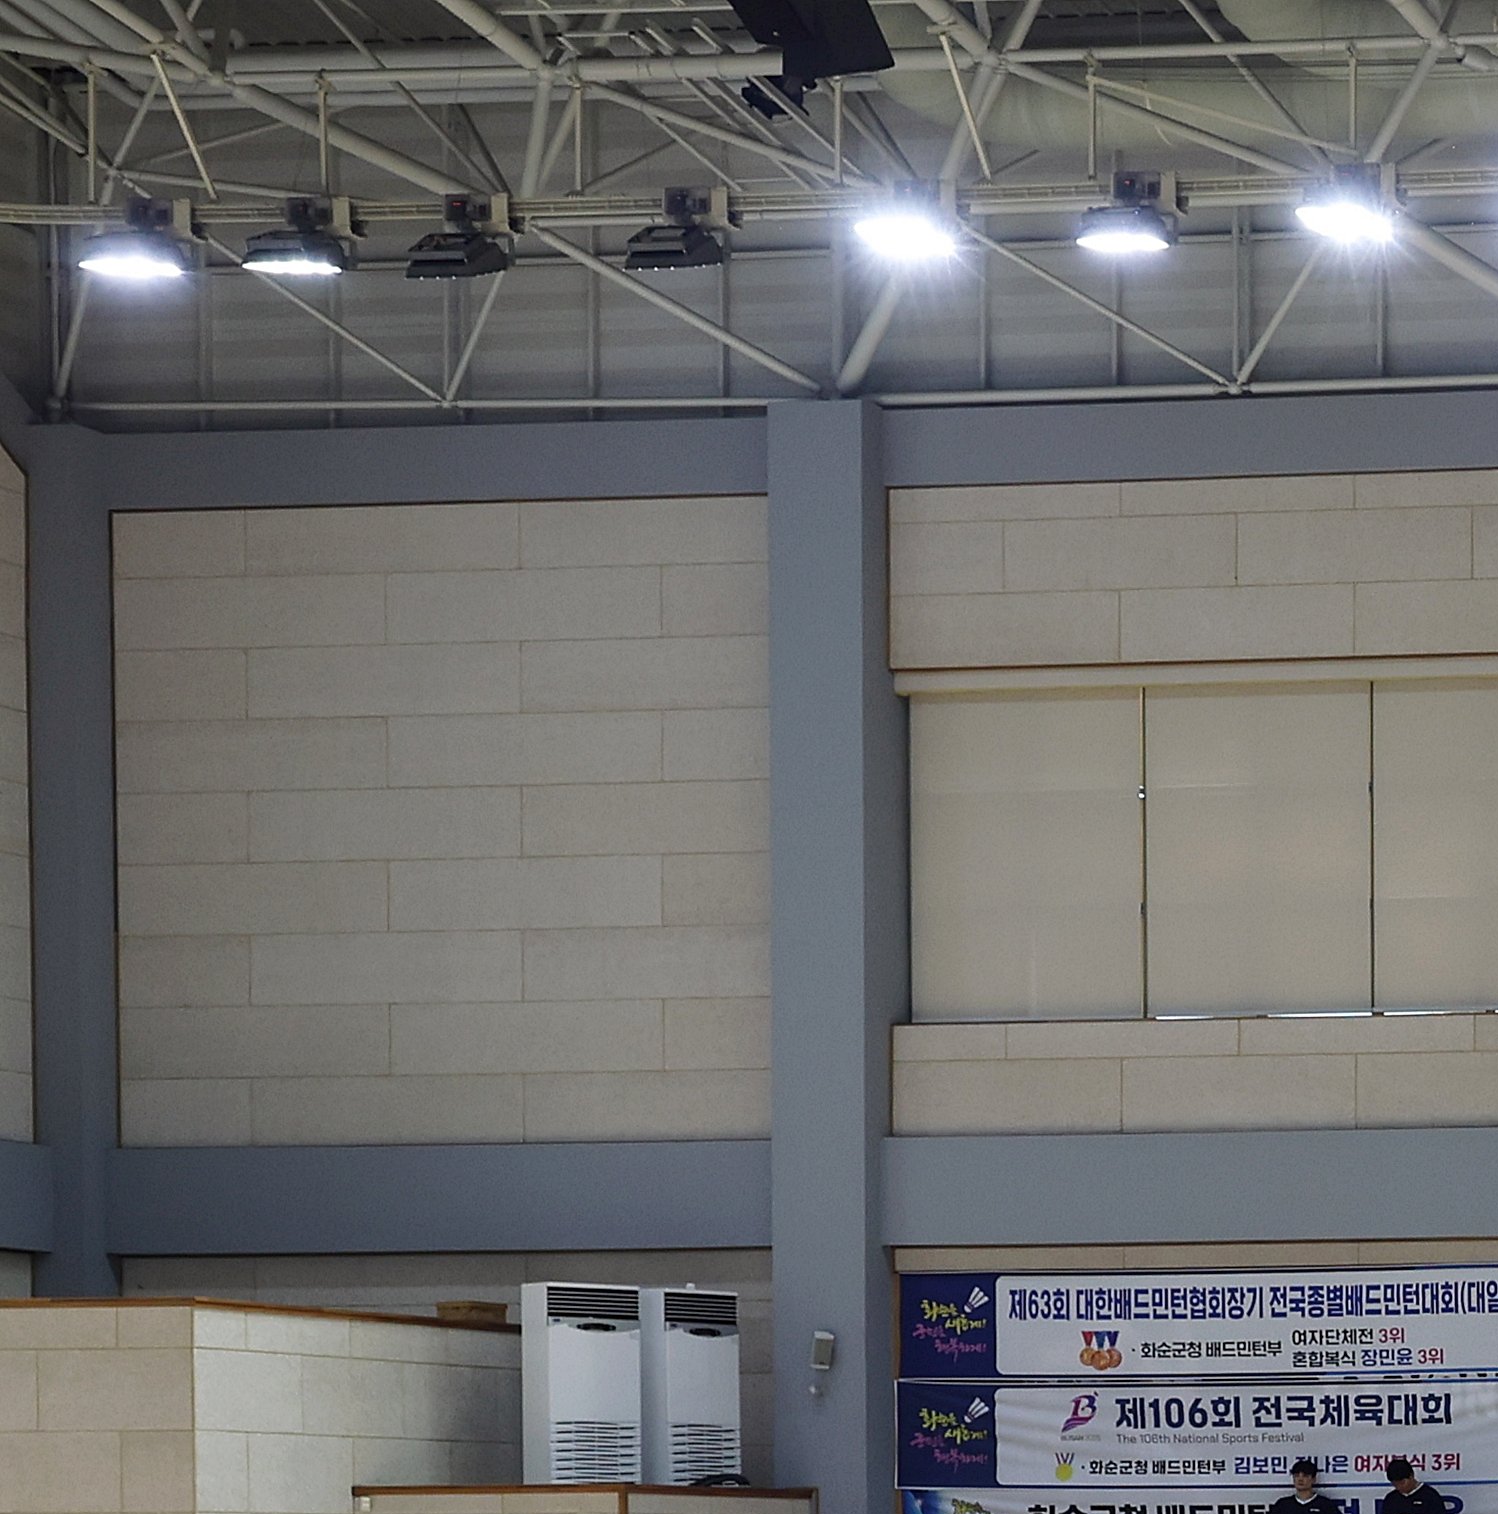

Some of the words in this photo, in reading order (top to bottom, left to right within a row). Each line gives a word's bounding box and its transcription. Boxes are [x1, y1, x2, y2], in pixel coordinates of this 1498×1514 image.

[1008, 1288, 1071, 1321] 제63회
[1076, 1286, 1264, 1321] 대한배드민턴협회장기
[1292, 1328, 1374, 1346] 여자단체전
[1378, 1328, 1405, 1344] 3위
[1141, 1342, 1202, 1358] 화순군청
[1206, 1340, 1282, 1358] 배드민턴부
[1292, 1350, 1356, 1368] 혼합복식
[1417, 1348, 1444, 1365] 3위
[1115, 1396, 1241, 1429] 제106회
[1252, 1393, 1452, 1428] 전국체육대회
[1116, 1433, 1138, 1444] The
[1140, 1433, 1171, 1444] 106th
[1173, 1433, 1219, 1444] National
[1222, 1432, 1259, 1446] Sports
[1262, 1432, 1304, 1443] Festival
[1089, 1460, 1148, 1476] 화순군청
[1152, 1460, 1226, 1475] 배드민턴부
[1431, 1453, 1460, 1470] 3위
